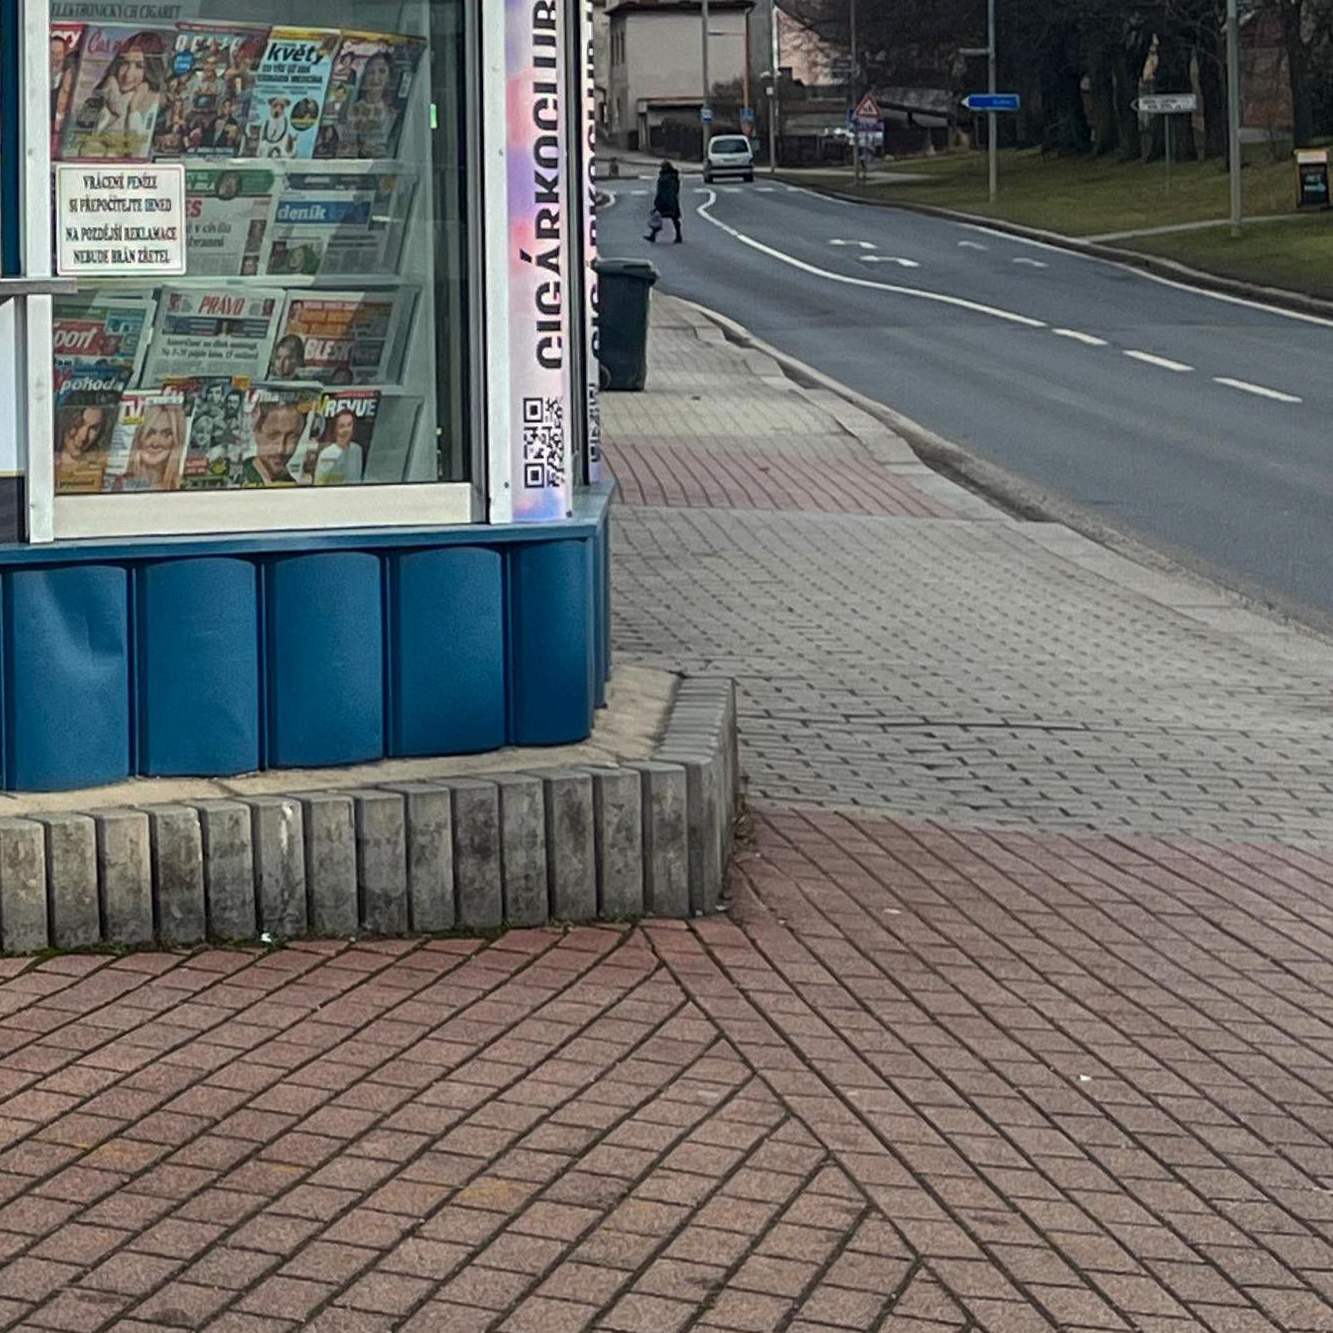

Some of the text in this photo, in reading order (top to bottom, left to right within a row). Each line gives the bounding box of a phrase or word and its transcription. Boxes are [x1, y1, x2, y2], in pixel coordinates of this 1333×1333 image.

[267, 43, 324, 65] květy
[277, 204, 326, 221] deník
[65, 227, 79, 241] NA
[197, 293, 247, 317] PRÁVO
[324, 398, 378, 418] REVUE
